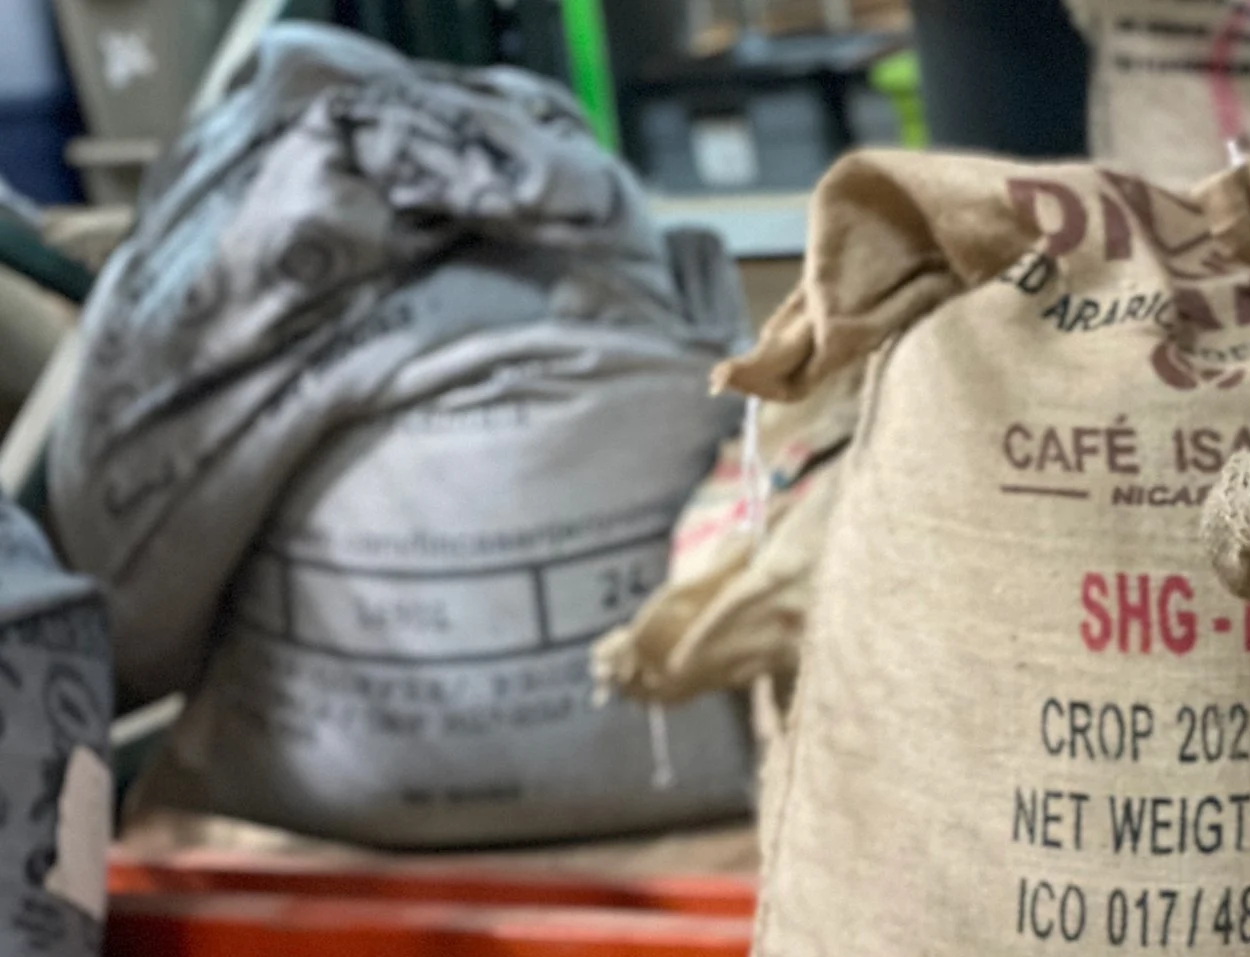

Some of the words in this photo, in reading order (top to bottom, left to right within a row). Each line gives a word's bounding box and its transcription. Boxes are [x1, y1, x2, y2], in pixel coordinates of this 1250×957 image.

[1003, 414, 1141, 474] CAFÉ
[1041, 697, 1153, 763] CROP
[1012, 786, 1089, 851] NET
[1016, 877, 1086, 942] ICO
